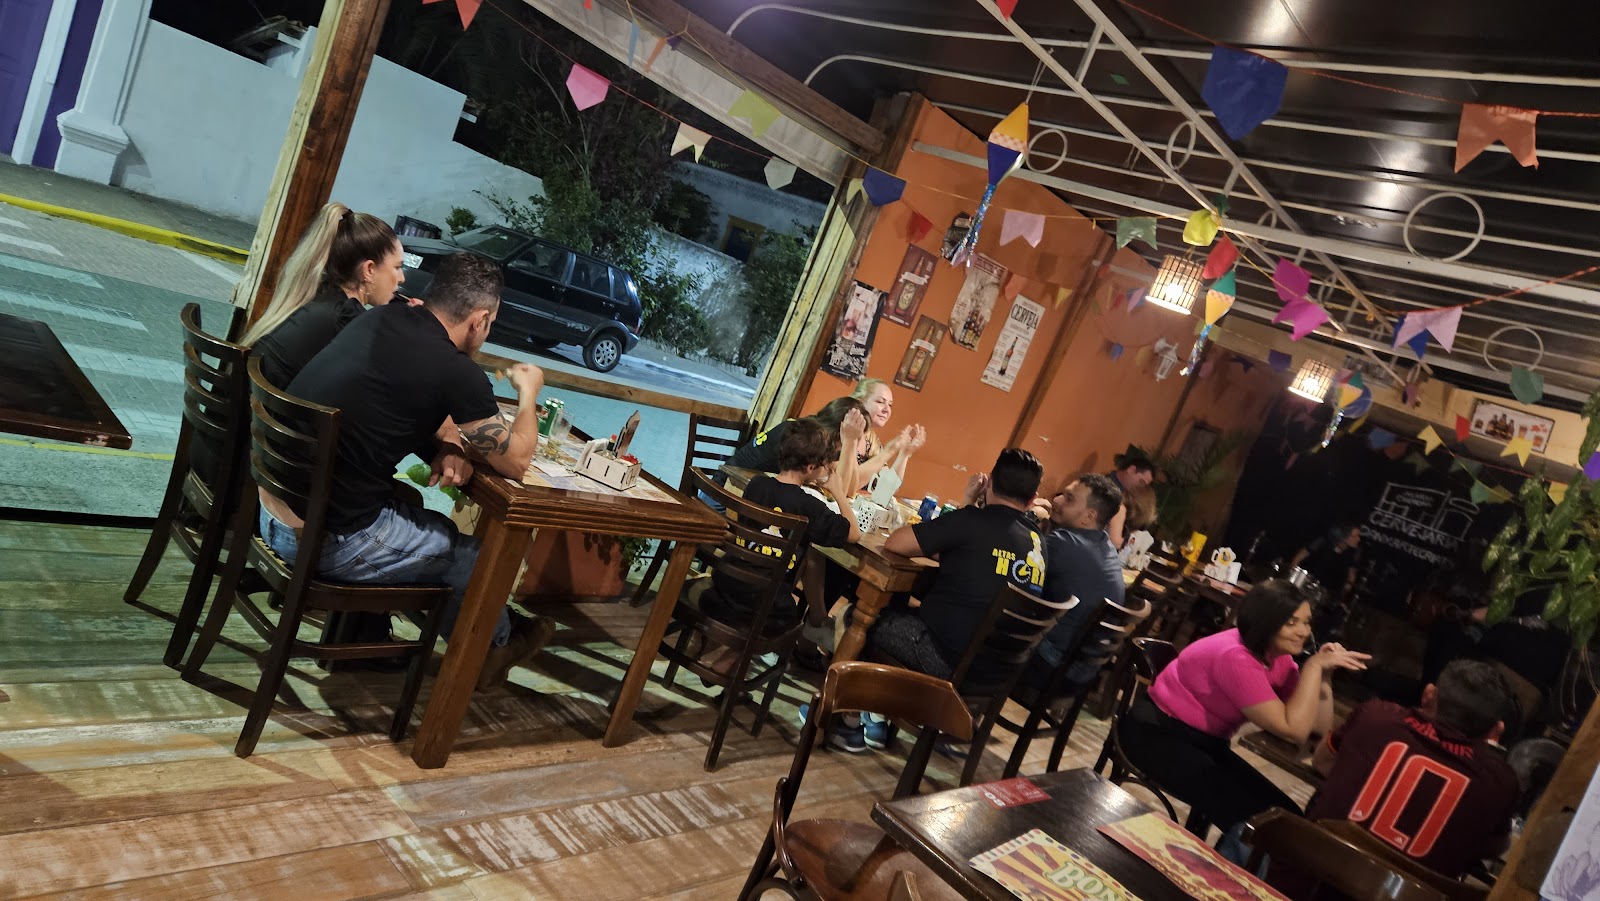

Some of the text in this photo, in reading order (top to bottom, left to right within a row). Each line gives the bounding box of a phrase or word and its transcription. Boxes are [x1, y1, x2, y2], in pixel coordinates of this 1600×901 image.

[1011, 304, 1039, 329] CERVEJA
[992, 548, 1016, 561] ALTAS
[1348, 741, 1471, 858] 10
